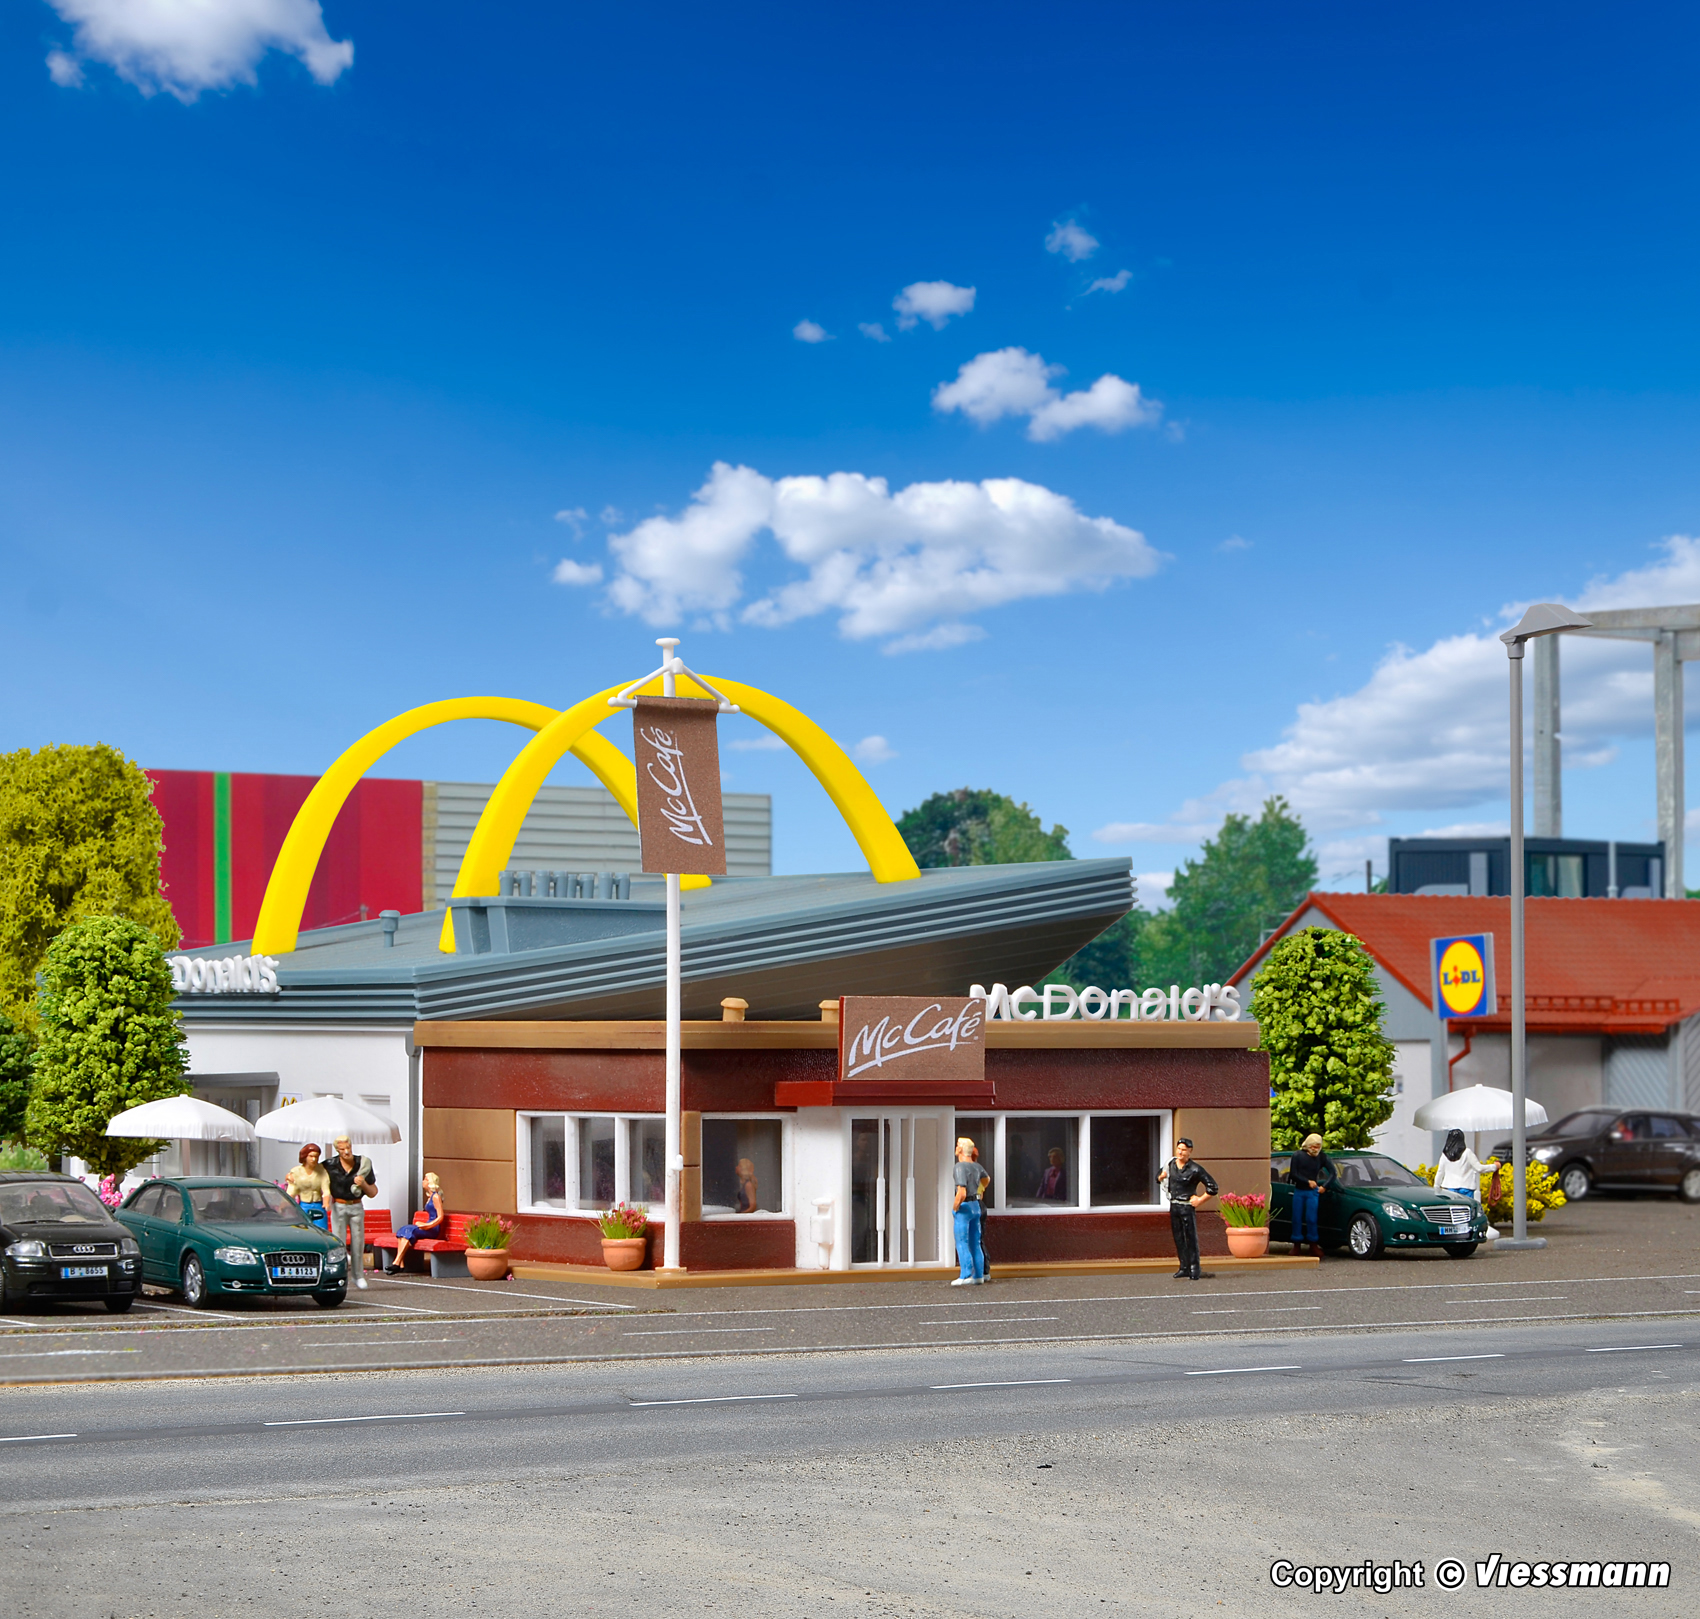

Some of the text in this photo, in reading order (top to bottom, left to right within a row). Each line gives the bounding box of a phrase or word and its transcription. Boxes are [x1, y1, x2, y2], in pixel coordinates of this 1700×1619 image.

[640, 726, 704, 845] McCafé
[165, 953, 281, 993] Donald's
[969, 983, 1241, 1021] McDonald's
[848, 999, 982, 1068] McCafé
